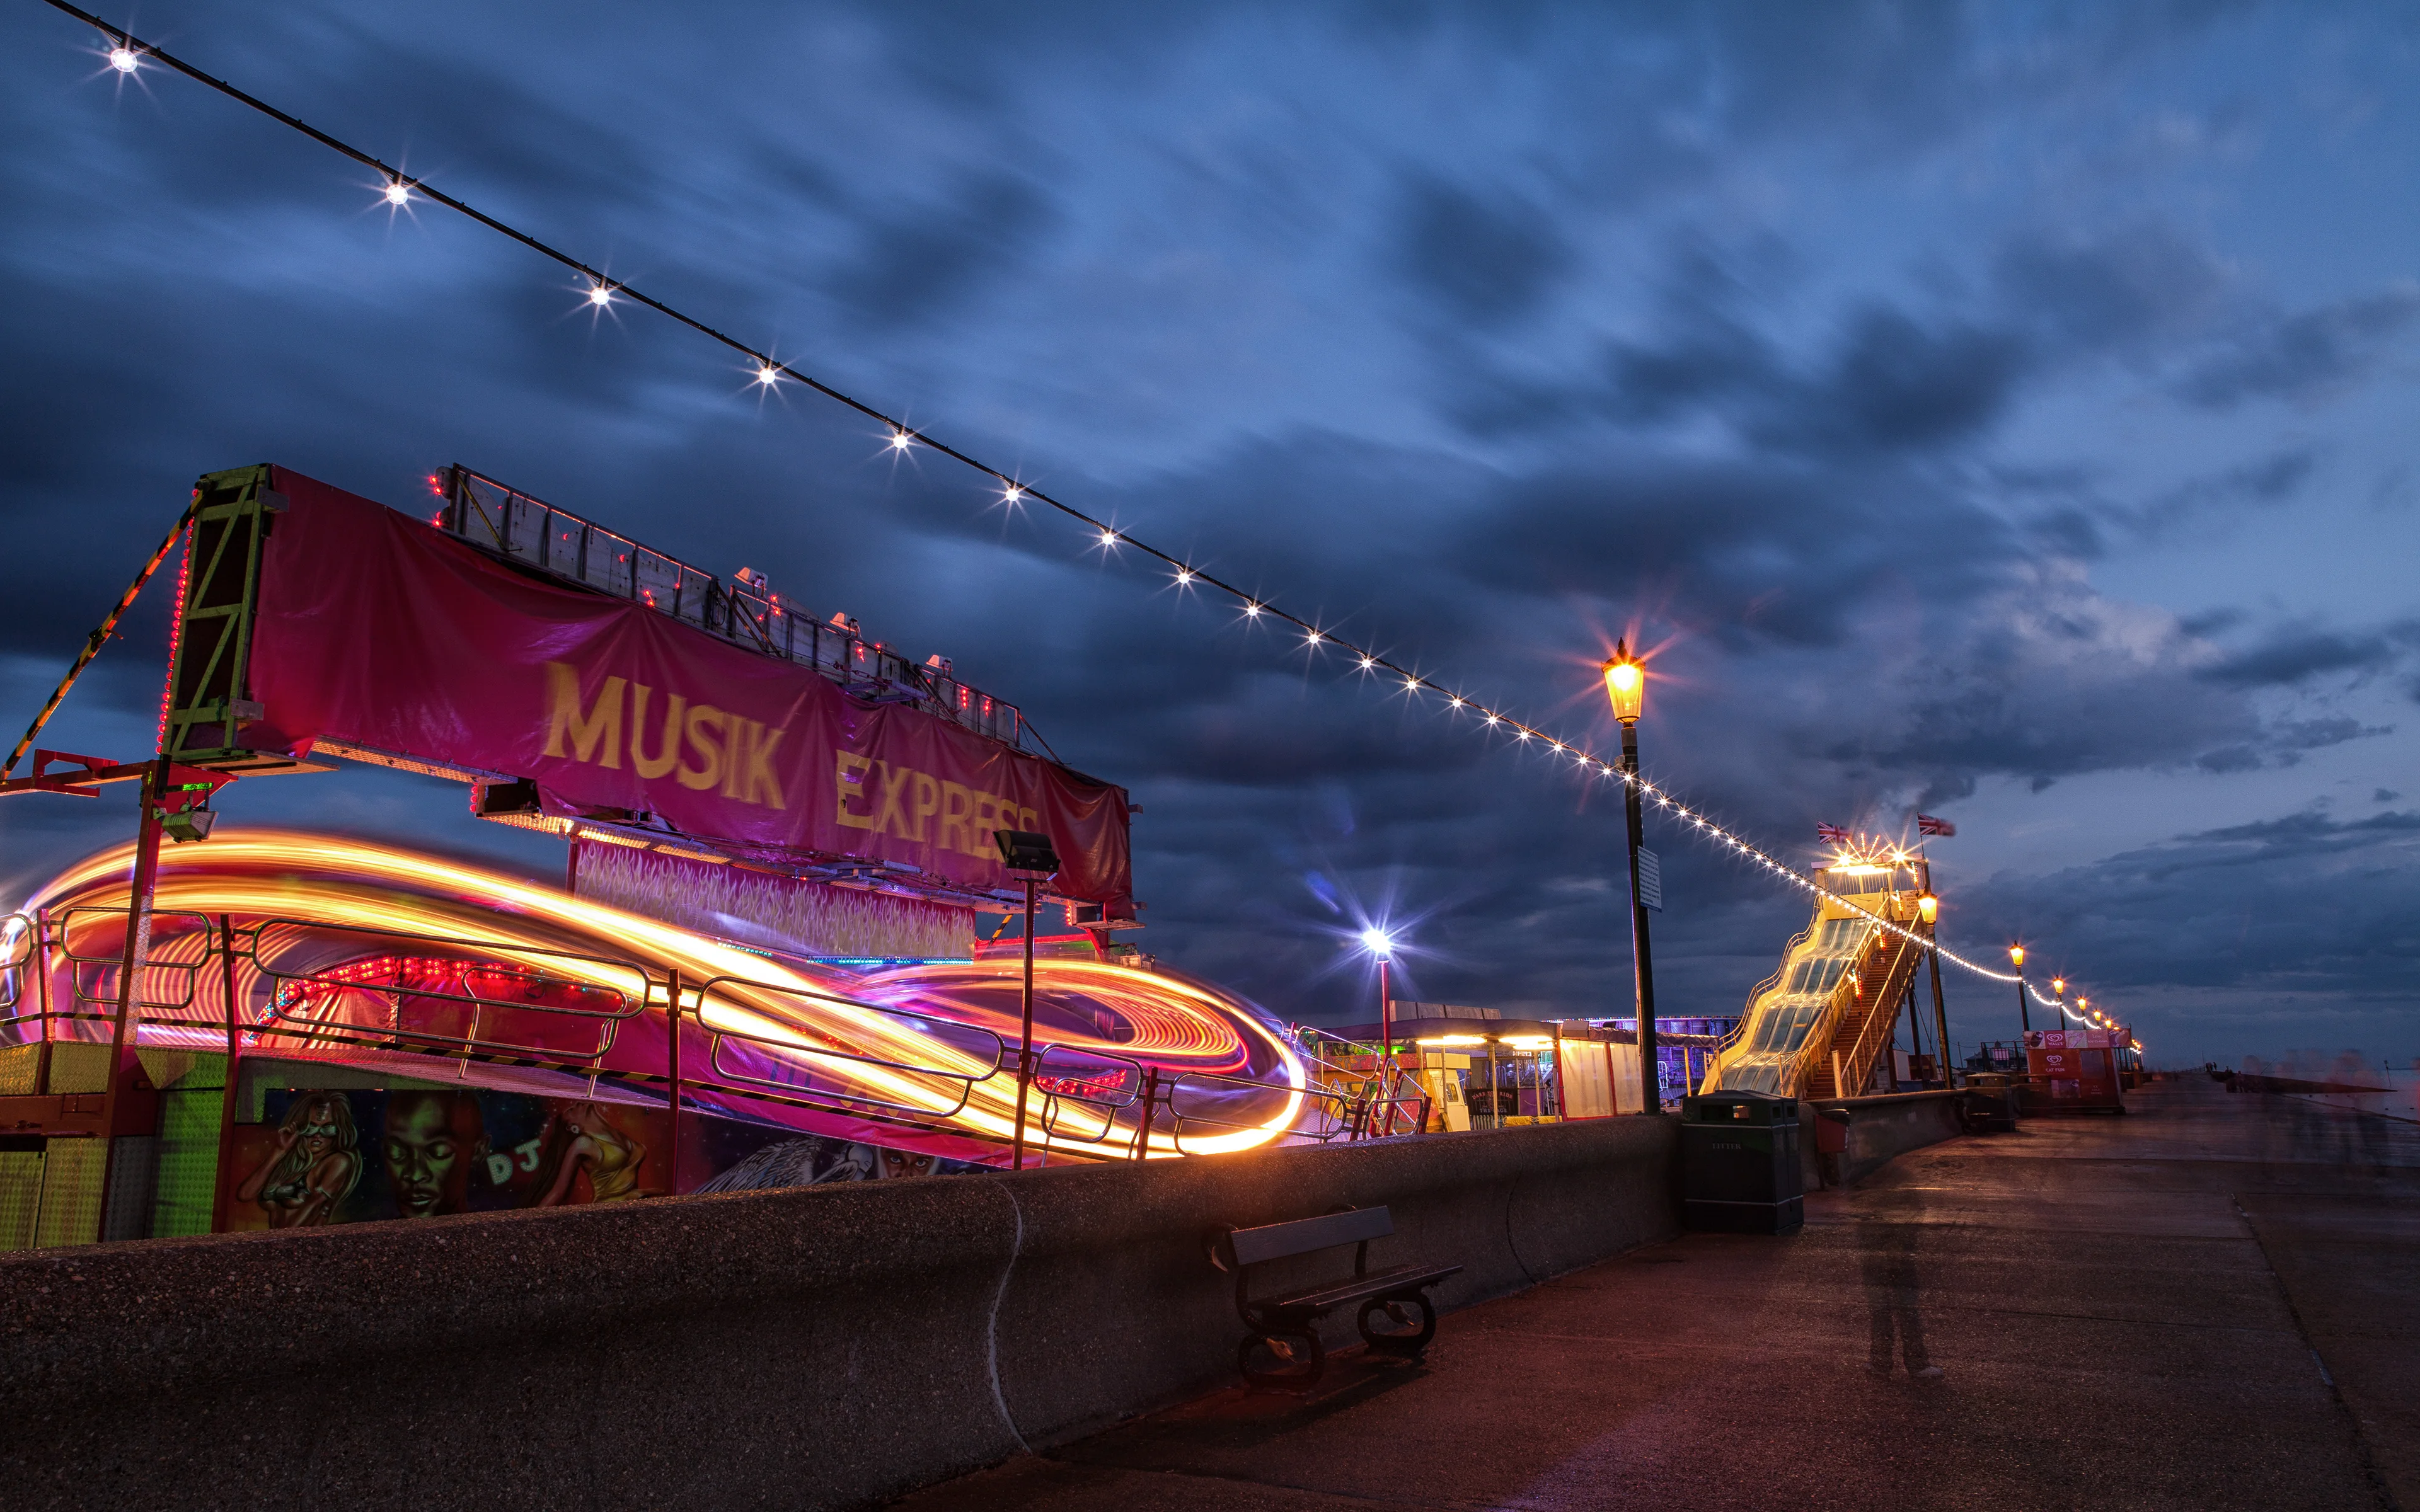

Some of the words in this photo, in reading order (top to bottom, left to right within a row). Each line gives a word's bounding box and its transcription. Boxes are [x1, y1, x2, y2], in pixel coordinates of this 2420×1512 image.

[543, 662, 786, 811] MUSIK
[1472, 1091, 1485, 1099] DARE
[1499, 1091, 1513, 1099] RIDE
[486, 1138, 542, 1186] DJ
